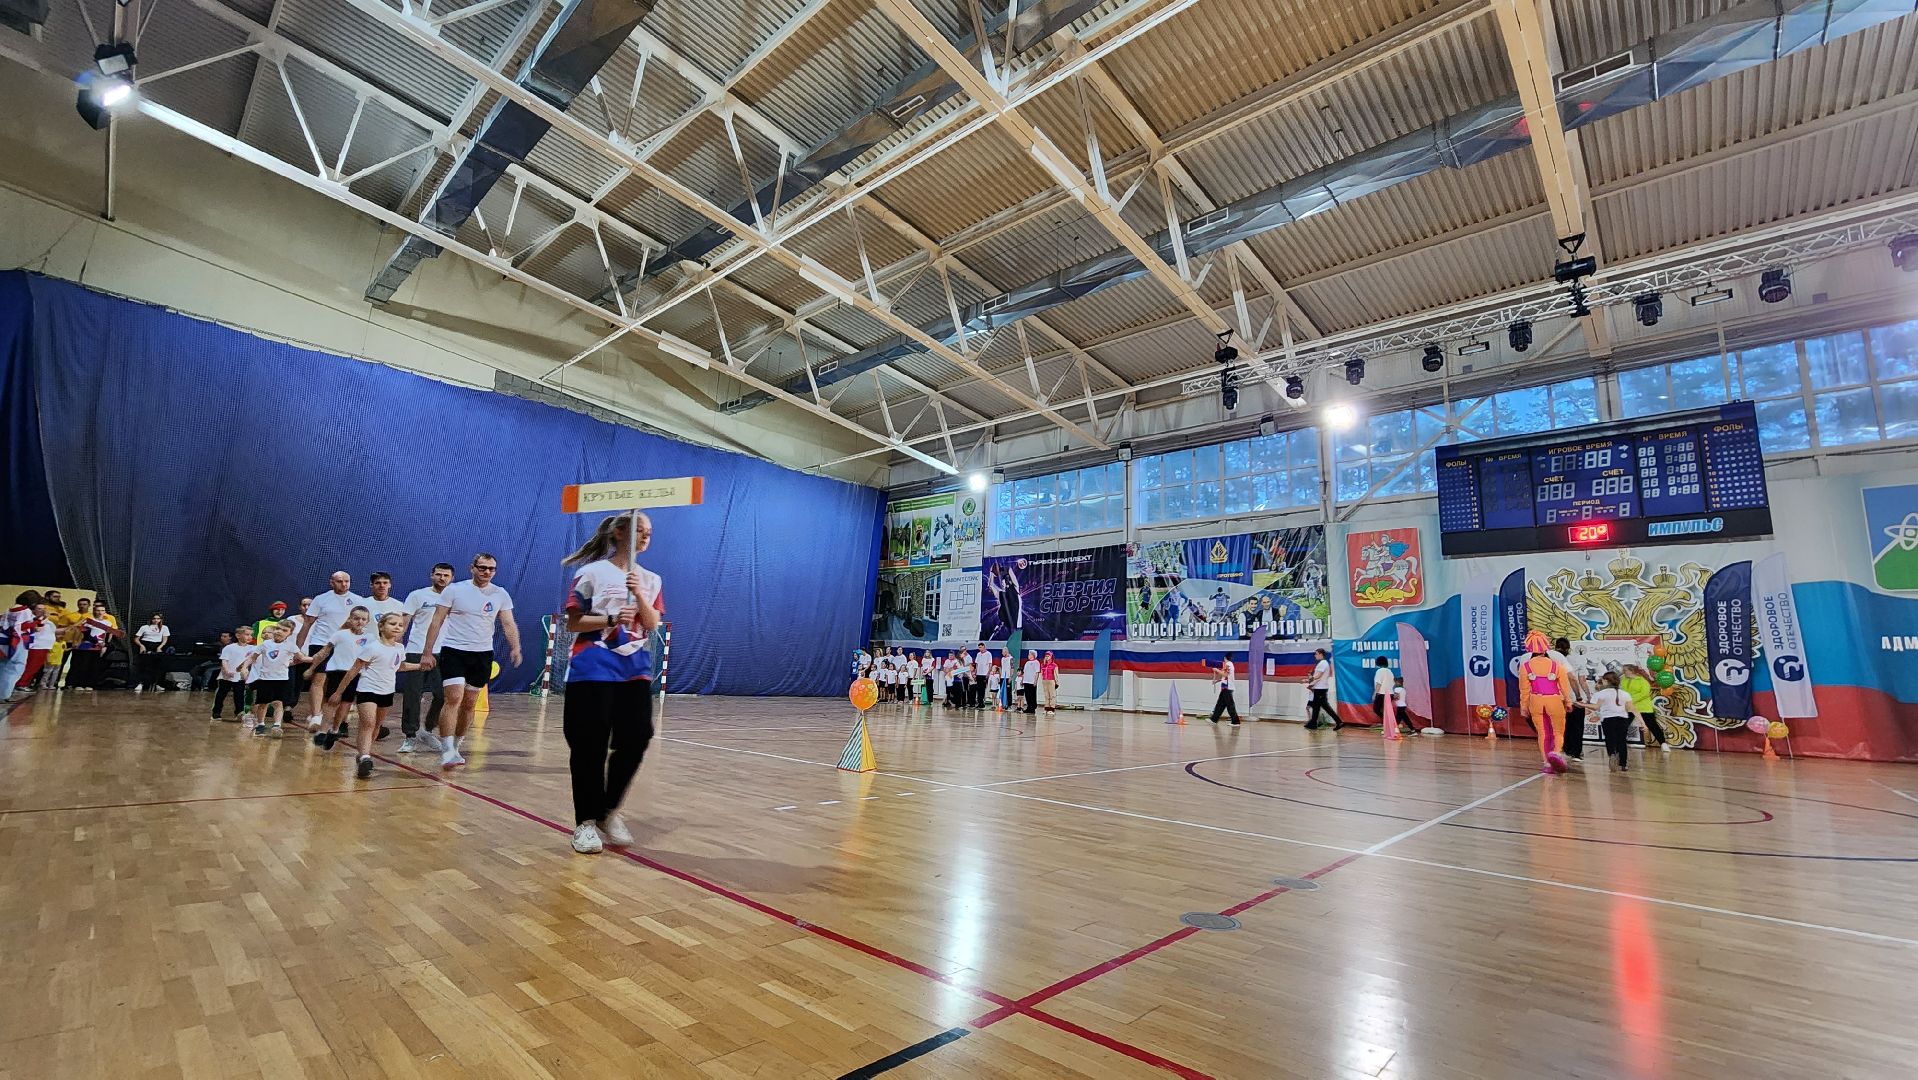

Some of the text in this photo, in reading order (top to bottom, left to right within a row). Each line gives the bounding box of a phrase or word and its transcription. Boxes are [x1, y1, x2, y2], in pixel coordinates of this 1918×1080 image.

[1658, 431, 1687, 440] ВРЕМЯ
[1714, 424, 1743, 432] ФОЛЫ
[1548, 441, 1613, 455] ИГРОВОЕ ВРЕМЯ
[1445, 460, 1467, 468] ФОЛЫ
[583, 490, 633, 503] КРУТЫЕ
[1648, 518, 1724, 536] ИМПУЛЬС
[1028, 554, 1092, 566] ТУРБОКОМПЛЕКТ
[1042, 578, 1117, 598] ЭНЕРГИЯ
[1040, 595, 1114, 613] СПОРТА
[1132, 623, 1182, 637] СПОНСОР
[1187, 621, 1233, 637] СПОРТА
[1239, 622, 1246, 636] В
[1507, 605, 1519, 652] ЗДОРОВОЕ
[1717, 600, 1730, 655] ЗДОРОВОЕ
[1731, 599, 1742, 655] ОТЕЧЕСТВО
[1763, 595, 1784, 650] ЗДОРОВОЕ
[1777, 592, 1797, 650] ОТЕЧЕСТВО
